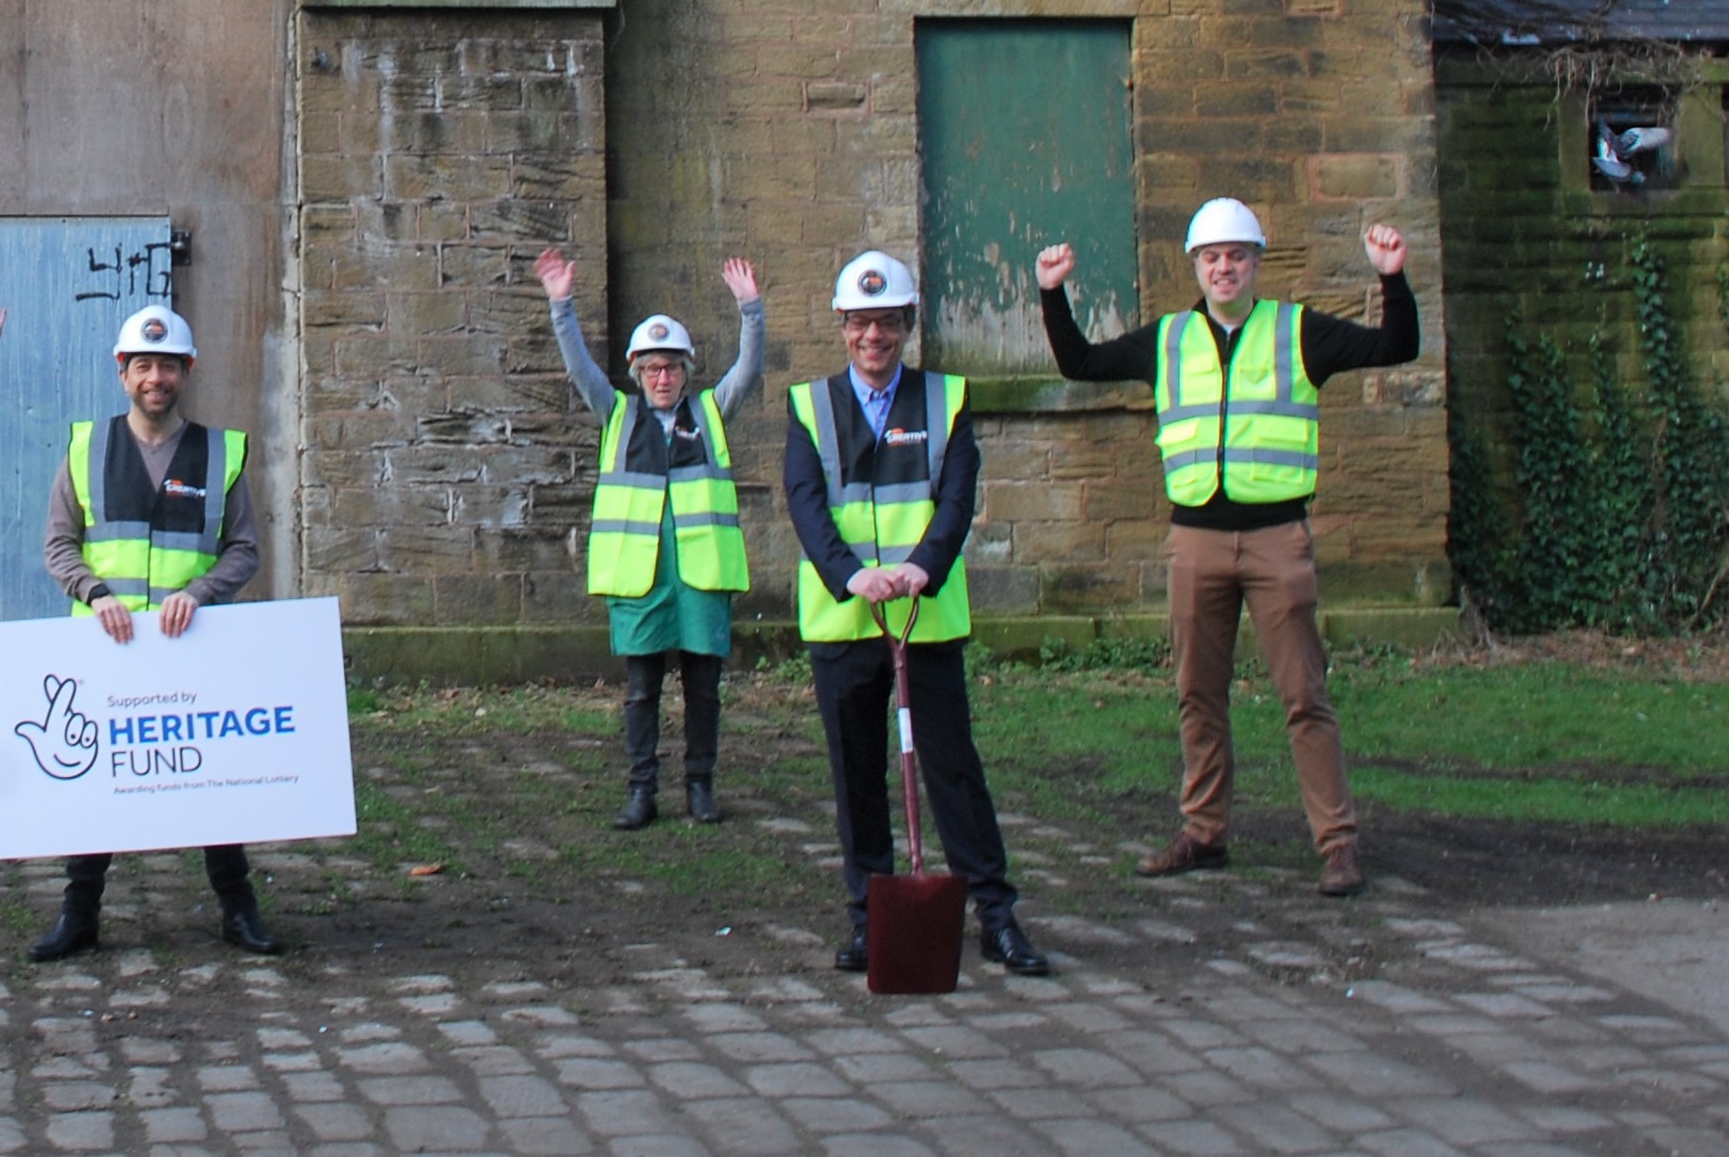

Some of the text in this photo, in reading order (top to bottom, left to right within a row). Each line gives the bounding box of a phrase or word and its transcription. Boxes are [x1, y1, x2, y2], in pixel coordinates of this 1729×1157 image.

[107, 690, 198, 708] Supported by
[108, 705, 296, 745] HERITAGE
[111, 746, 203, 778] FUND
[114, 775, 300, 795] Awarding funds from The National Lottery
